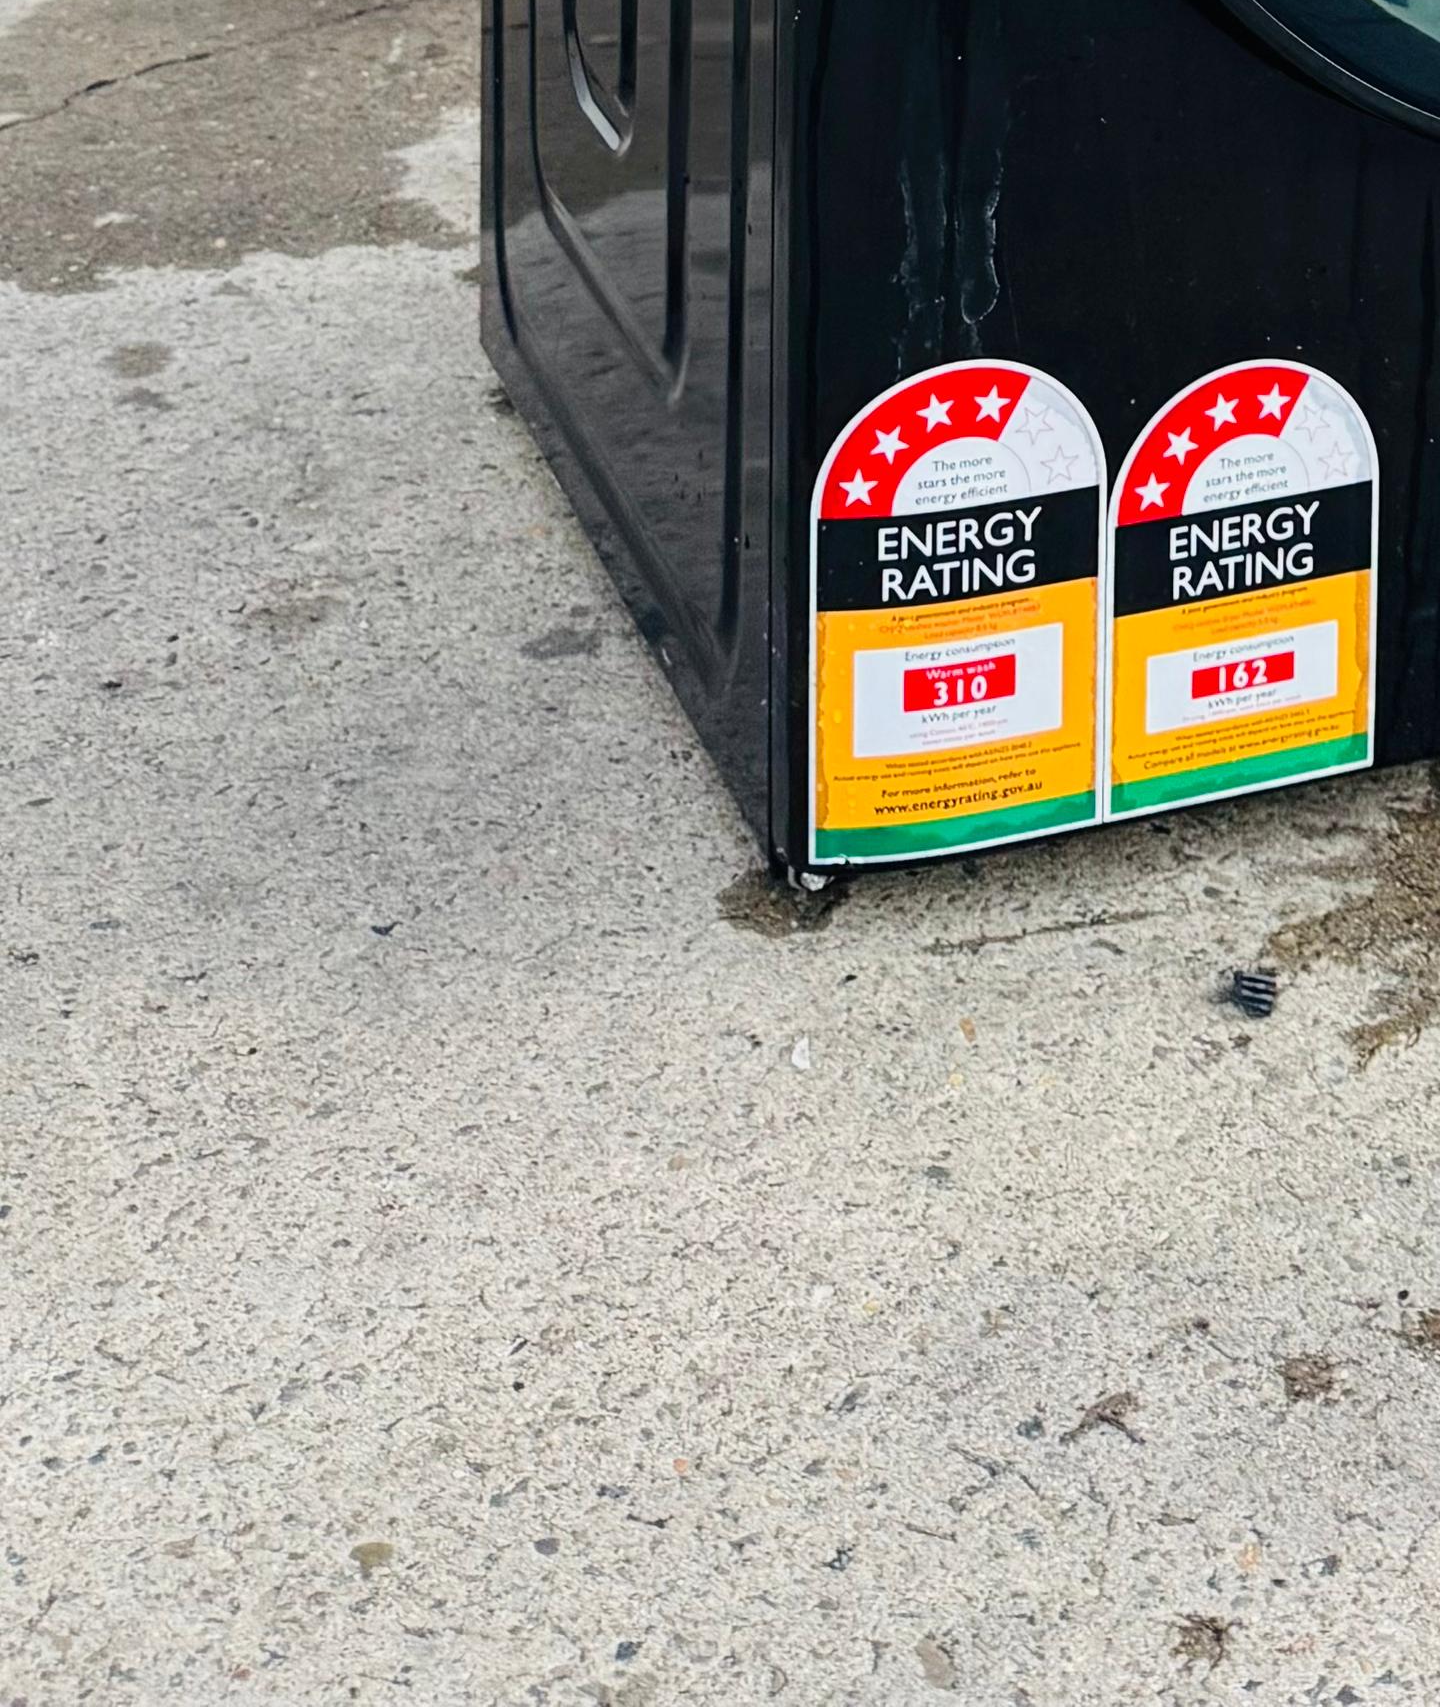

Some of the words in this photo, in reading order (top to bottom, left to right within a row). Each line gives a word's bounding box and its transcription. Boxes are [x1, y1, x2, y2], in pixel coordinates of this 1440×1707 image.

[933, 460, 956, 472] The
[959, 456, 993, 468] more
[1220, 458, 1241, 469] The
[1244, 453, 1274, 465] more
[918, 477, 947, 490] stars
[951, 475, 970, 486] the
[973, 469, 1006, 482] more
[1206, 476, 1232, 488] stars
[1236, 471, 1254, 482] the
[1256, 465, 1287, 477] more
[915, 492, 957, 505] energy
[961, 484, 1008, 499] efficient
[1203, 489, 1240, 502] energy
[1244, 480, 1288, 495] efficient
[878, 506, 1042, 562] ENERGY
[1169, 500, 1320, 561] ENERGY
[882, 549, 1036, 602] RATING
[1173, 542, 1314, 600] RATING
[905, 651, 942, 662] Energy
[945, 638, 1015, 657] consumption
[1193, 650, 1226, 662] Energy
[1230, 635, 1295, 655] consumption
[926, 668, 963, 680] Warm
[966, 661, 996, 675] wash
[1218, 658, 1268, 693] 162
[933, 675, 987, 706] 310
[1207, 697, 1233, 709] kWh
[1235, 694, 1253, 705] per
[1255, 689, 1277, 703] year
[921, 712, 949, 724] kWh
[952, 709, 970, 721] per
[973, 705, 996, 719] year
[881, 790, 899, 798] For
[902, 787, 930, 796] more
[998, 771, 1022, 780] refer
[874, 781, 1042, 815] www.energyrating.gov.au
